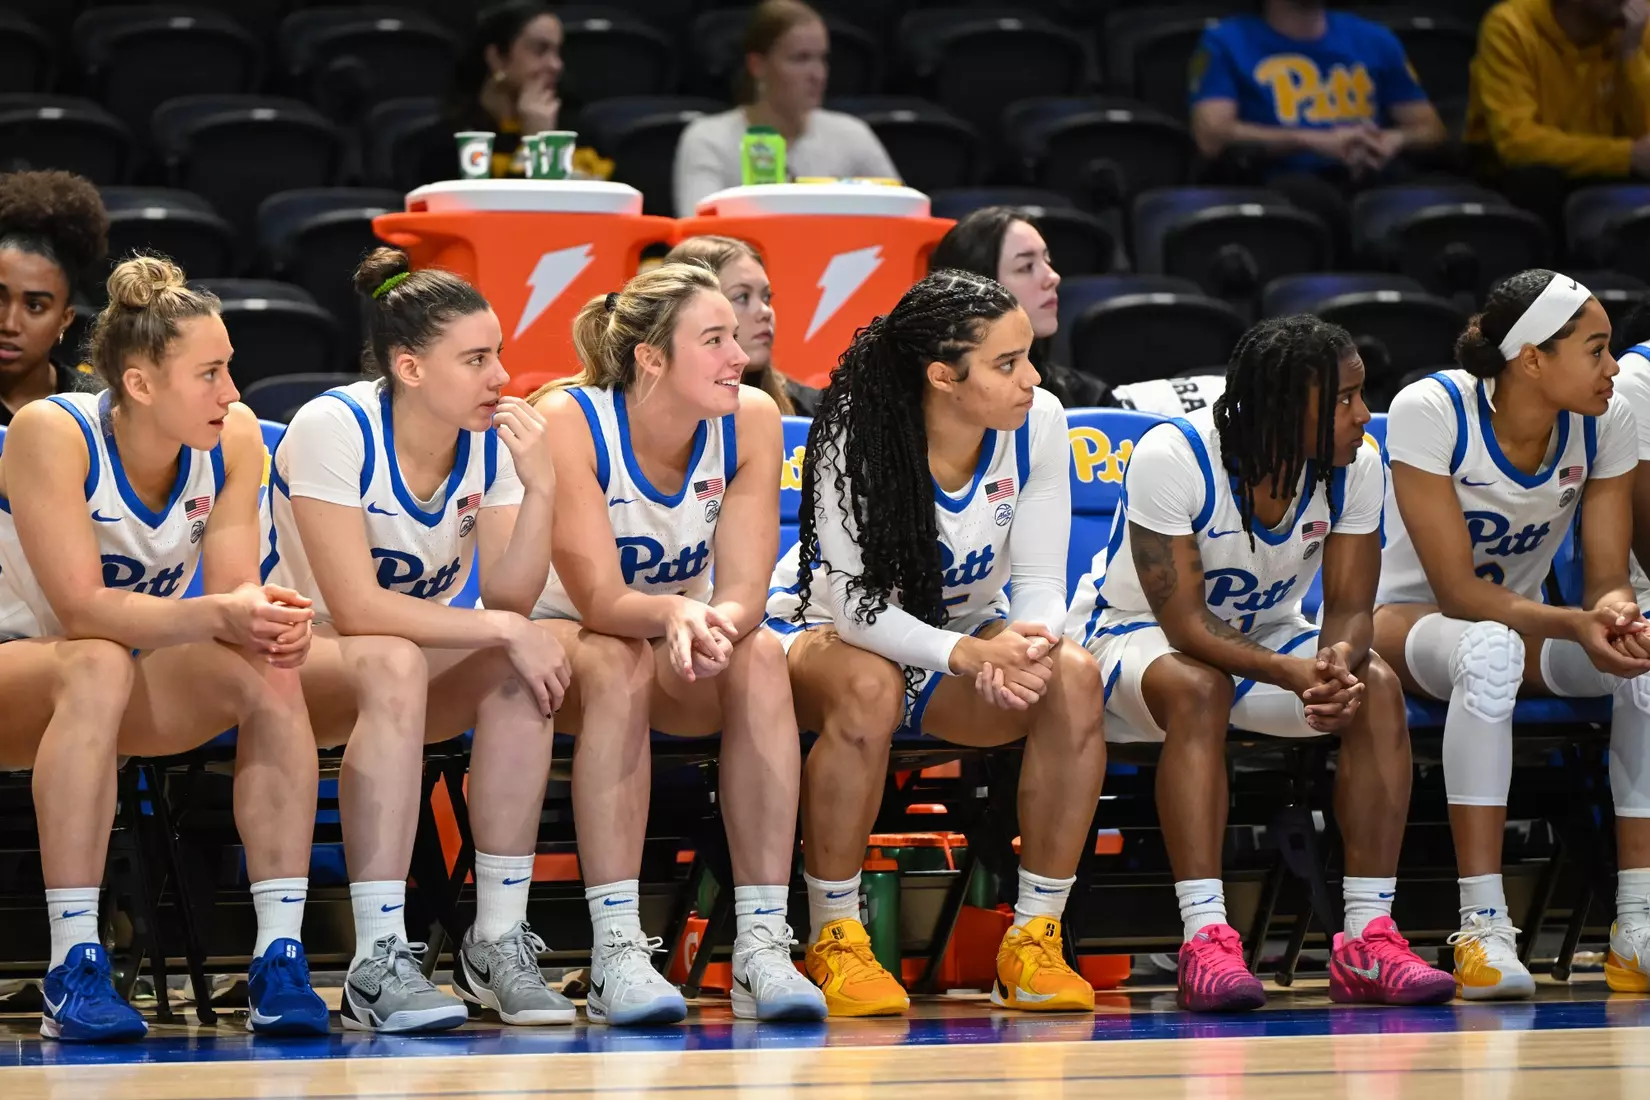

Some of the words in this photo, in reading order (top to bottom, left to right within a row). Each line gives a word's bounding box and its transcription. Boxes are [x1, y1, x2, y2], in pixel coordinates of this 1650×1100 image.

[1254, 54, 1375, 124] Pitt
[461, 140, 489, 176] G
[1068, 427, 1135, 483] Pit
[1463, 510, 1551, 557] Pitt
[614, 536, 709, 585] Pitt
[1204, 567, 1298, 611] Pitt
